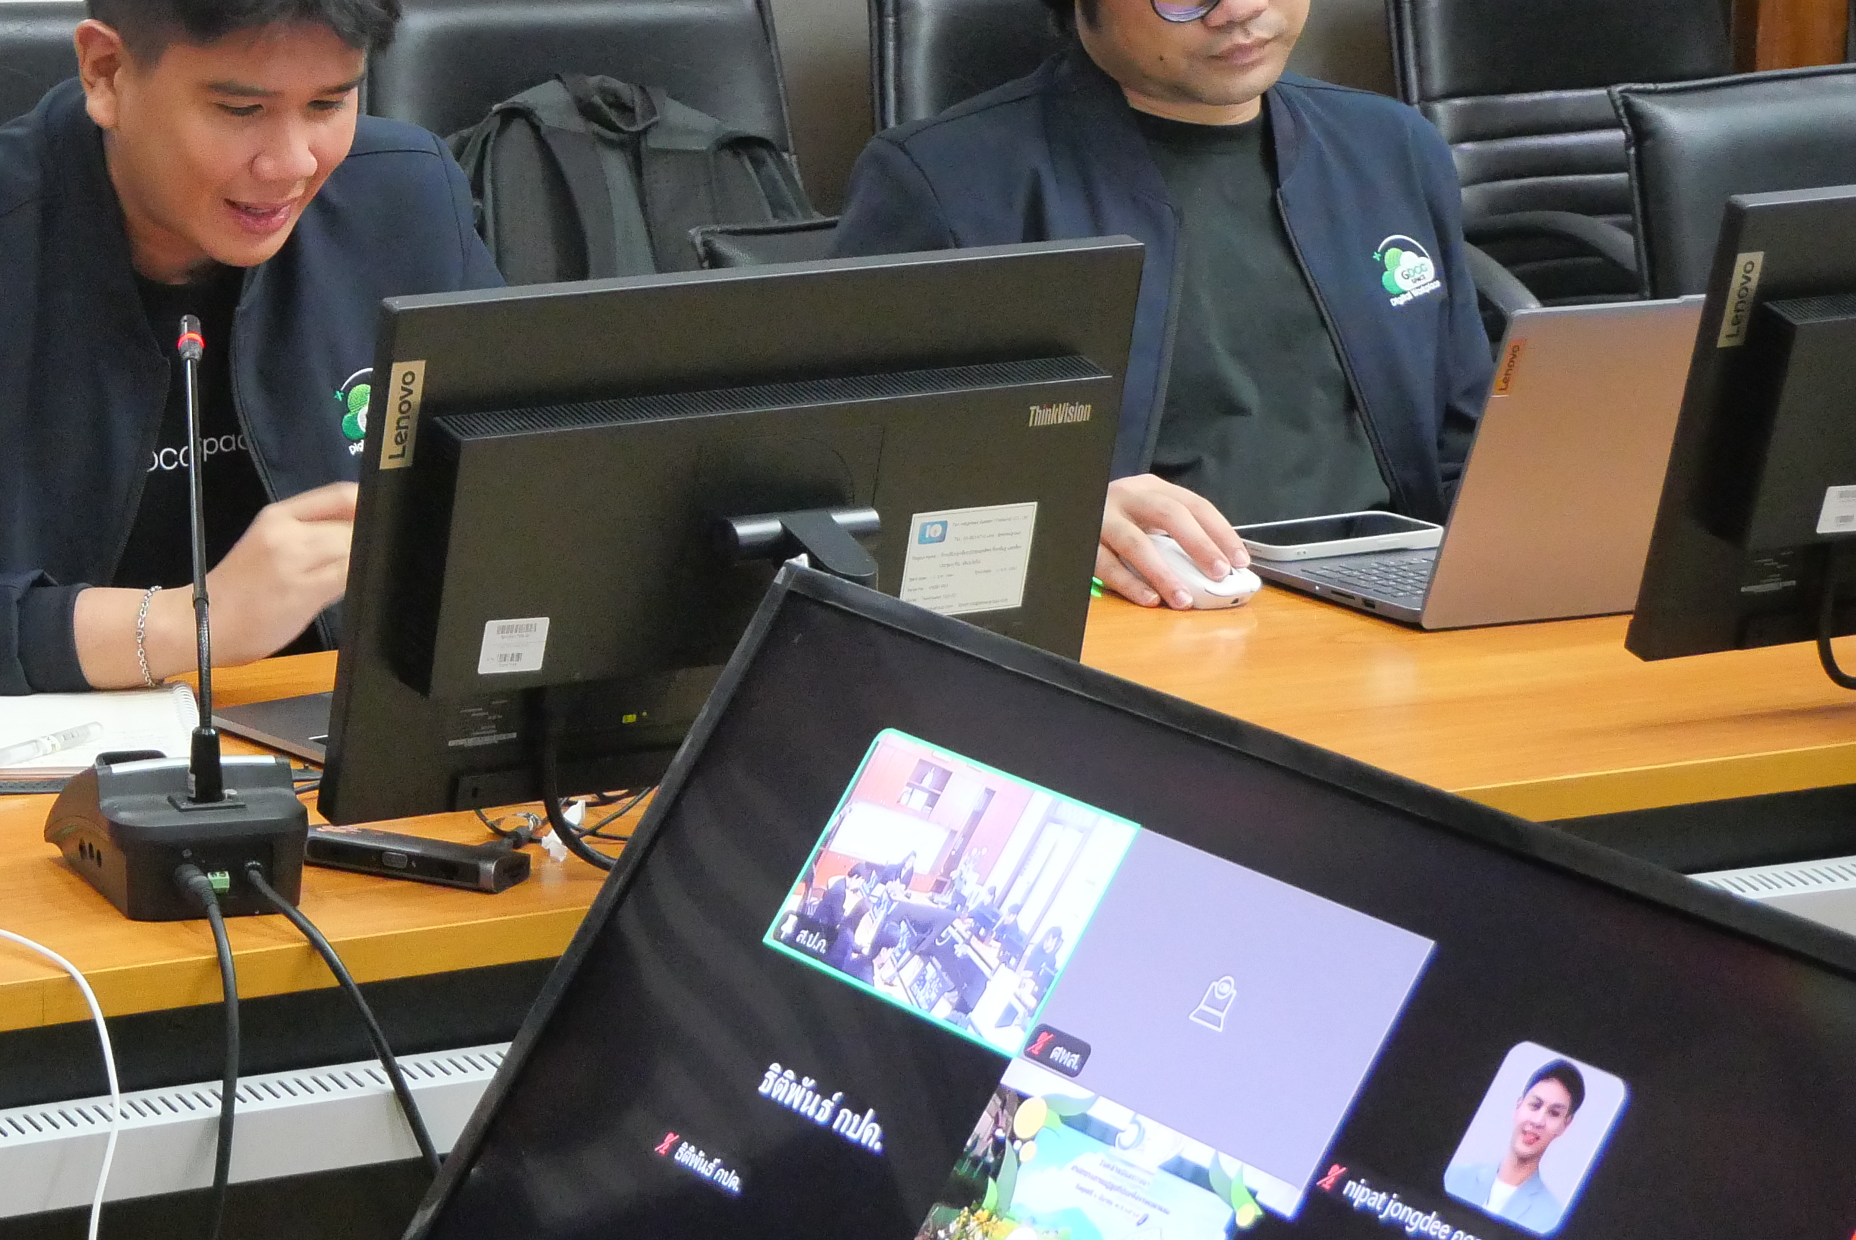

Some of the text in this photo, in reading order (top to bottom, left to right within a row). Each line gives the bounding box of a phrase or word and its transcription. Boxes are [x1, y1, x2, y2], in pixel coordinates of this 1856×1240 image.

[1725, 260, 1755, 339] Lenovo
[1498, 344, 1520, 392] Lenovo
[388, 370, 416, 460] Lenovo
[1029, 401, 1092, 427] ThinkVision
[757, 1062, 844, 1126] ธิติพันธ์
[1342, 1178, 1450, 1240] nipat jongdee
